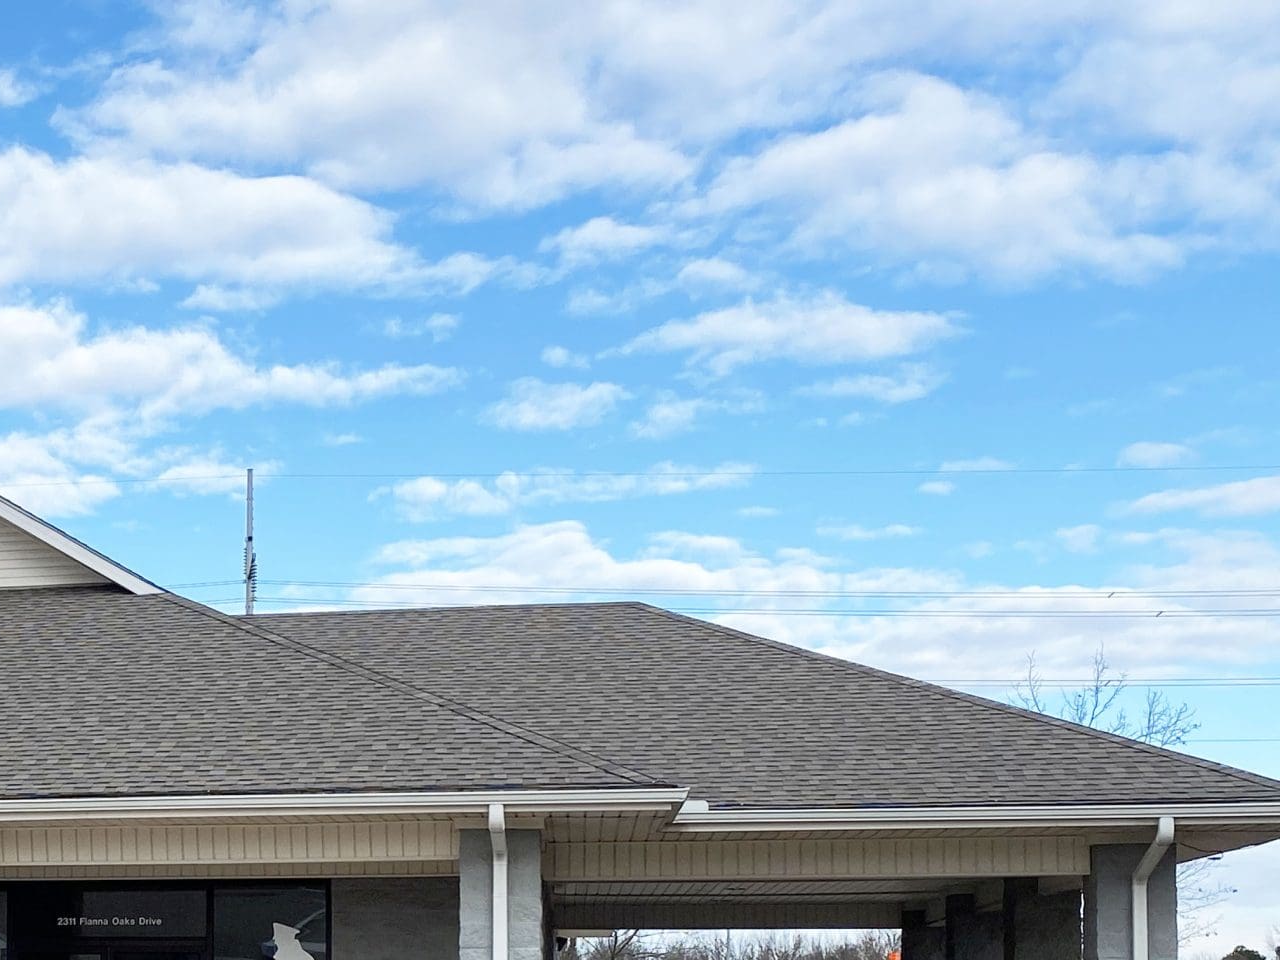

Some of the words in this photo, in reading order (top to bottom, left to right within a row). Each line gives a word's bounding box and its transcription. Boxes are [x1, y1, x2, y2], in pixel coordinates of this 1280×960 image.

[57, 917, 76, 926] 2311
[112, 917, 136, 926] Oaks
[138, 917, 162, 926] Drive
